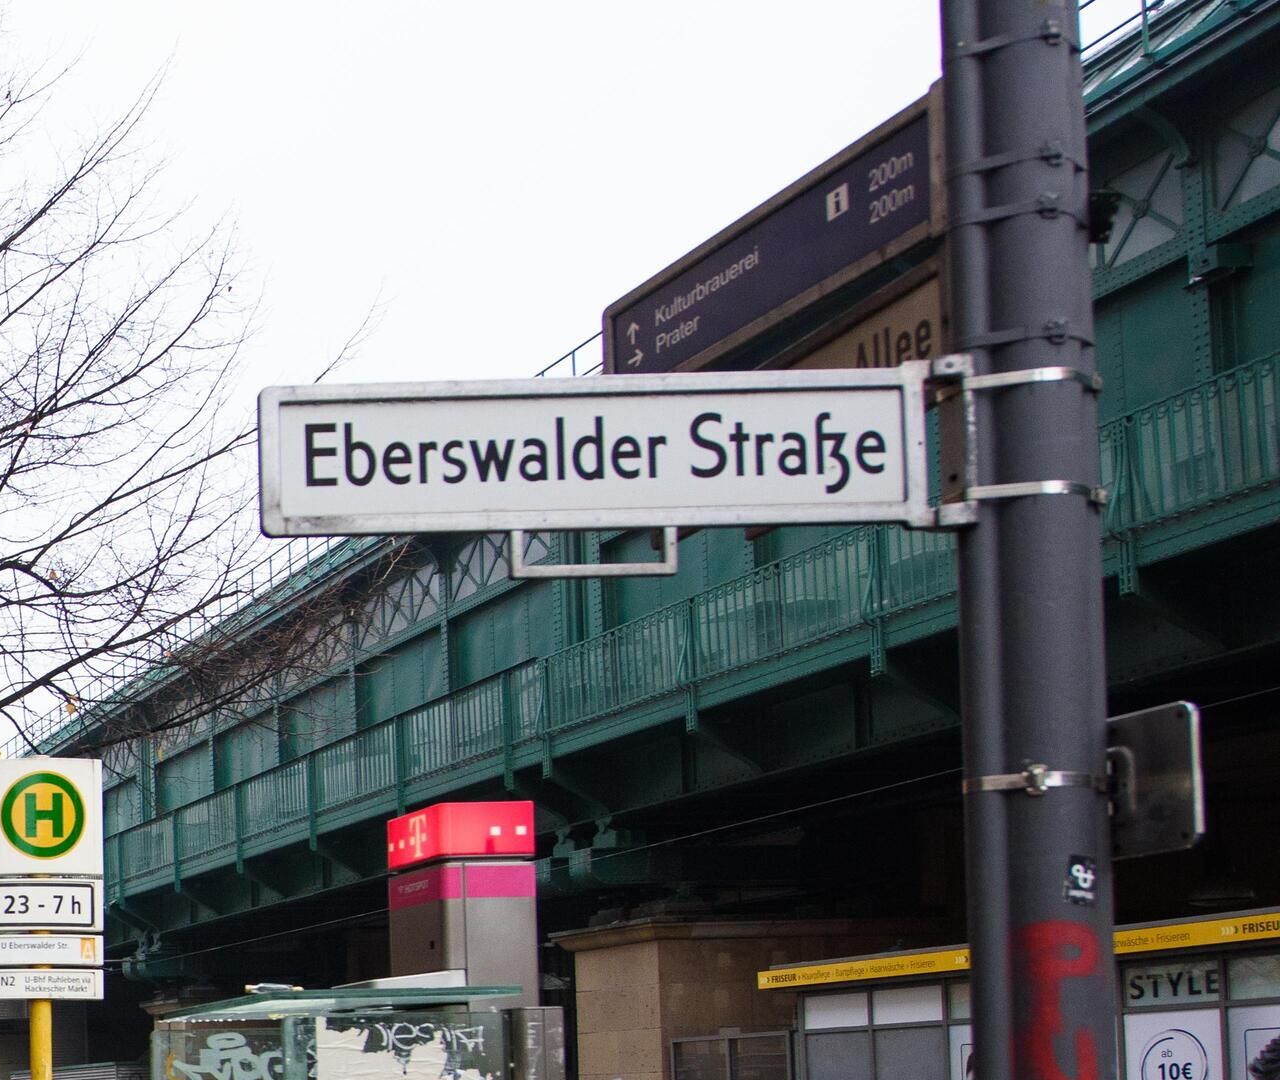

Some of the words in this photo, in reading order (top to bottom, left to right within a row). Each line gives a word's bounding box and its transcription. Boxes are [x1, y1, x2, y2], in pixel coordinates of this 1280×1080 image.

[868, 151, 914, 192] 200m
[868, 183, 915, 224] 200m
[654, 246, 760, 326] Kulturbrauerei
[655, 315, 701, 353] Prater
[855, 319, 933, 367] Allee
[303, 415, 667, 487] Eberswalder
[689, 411, 887, 494] Straße
[24, 792, 65, 838] H
[3, 895, 30, 915] 23
[52, 895, 64, 915] 7
[71, 895, 82, 915] h
[9, 941, 56, 950] Eberswalder
[1156, 932, 1191, 943] Frisieren
[1, 976, 16, 987] N2
[770, 973, 797, 984] FRISEUR
[1129, 968, 1220, 1000] STYLE
[1161, 1049, 1173, 1058] ab
[1157, 1062, 1193, 1080] 10€
